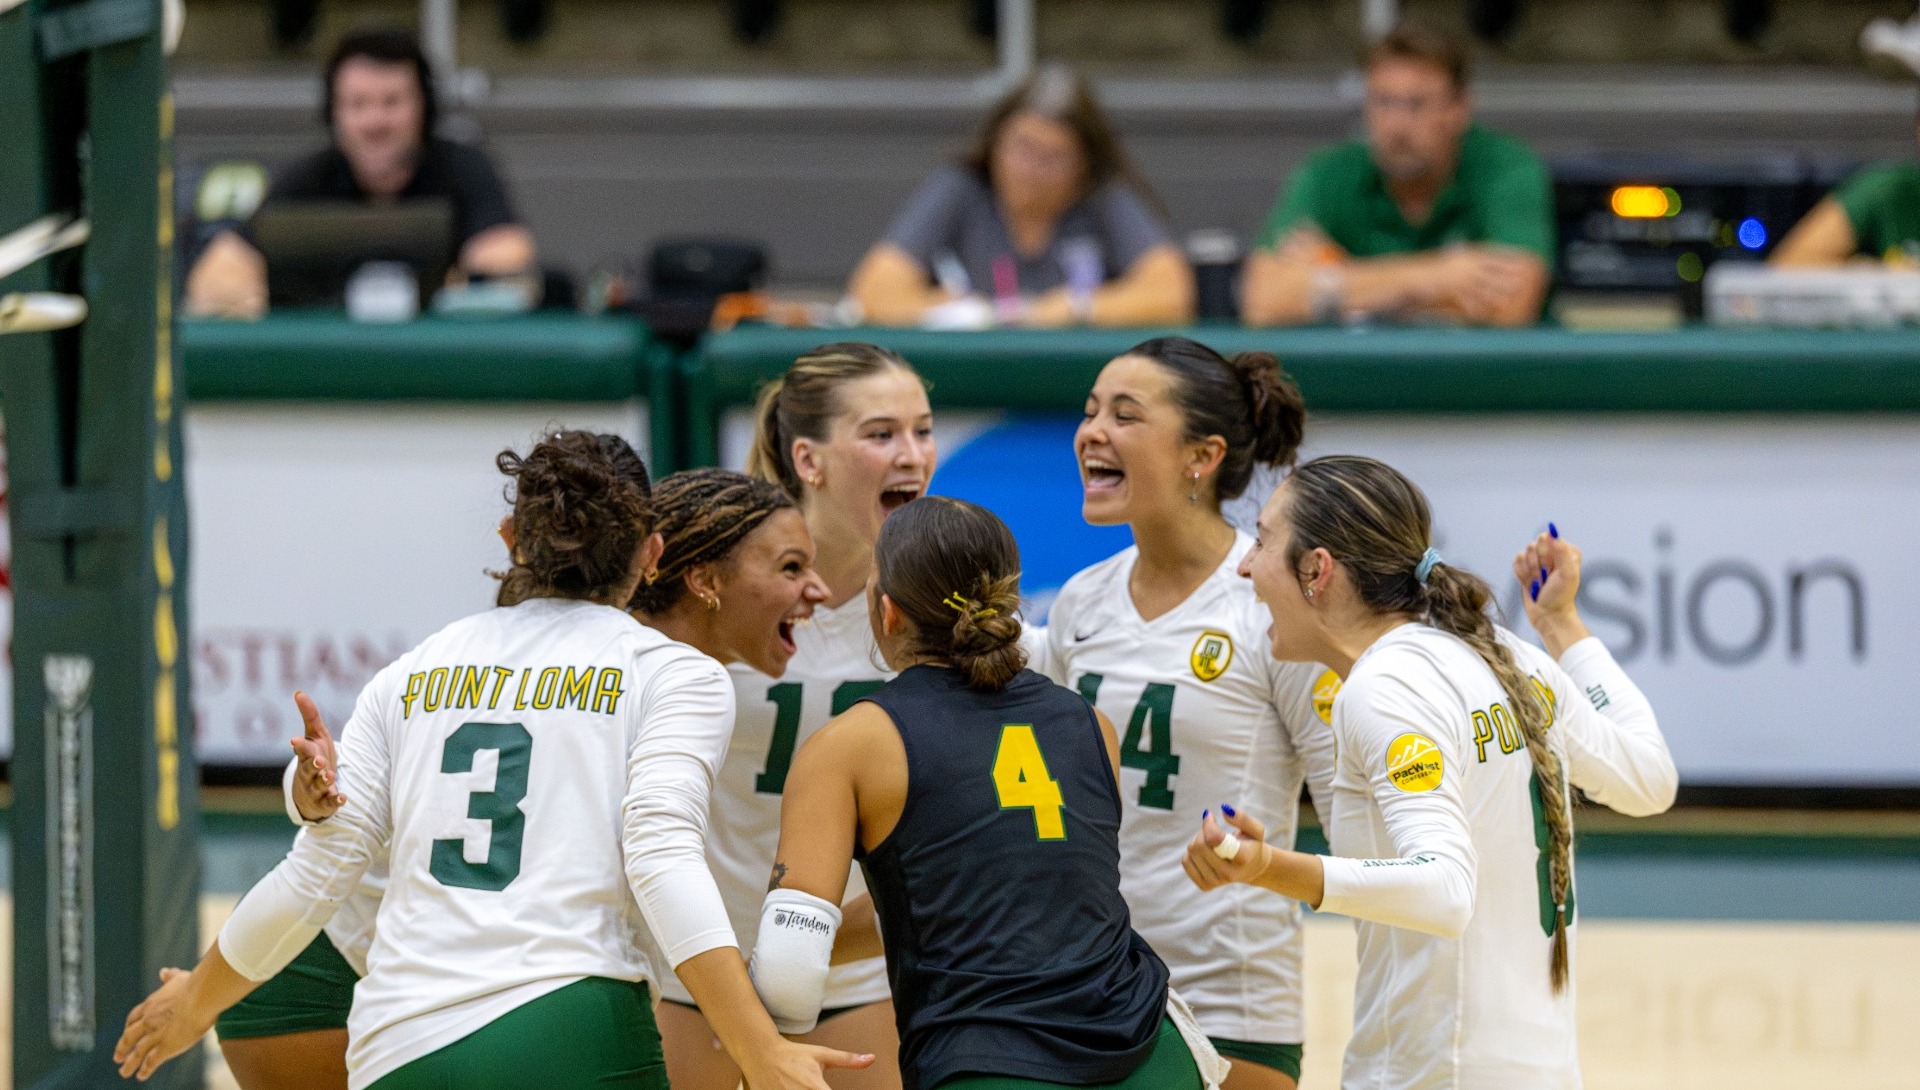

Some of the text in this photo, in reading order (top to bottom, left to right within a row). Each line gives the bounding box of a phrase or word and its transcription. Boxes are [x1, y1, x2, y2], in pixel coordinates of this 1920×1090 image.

[1505, 521, 1873, 668] sion
[190, 625, 410, 692] STIAN
[401, 665, 625, 720] POINT LOMA
[1586, 684, 1611, 711] JOY
[755, 679, 887, 795] 1
[992, 722, 1067, 842] 4
[1077, 671, 1181, 812] 4
[429, 721, 533, 892] 3
[775, 908, 831, 937] Tandem
